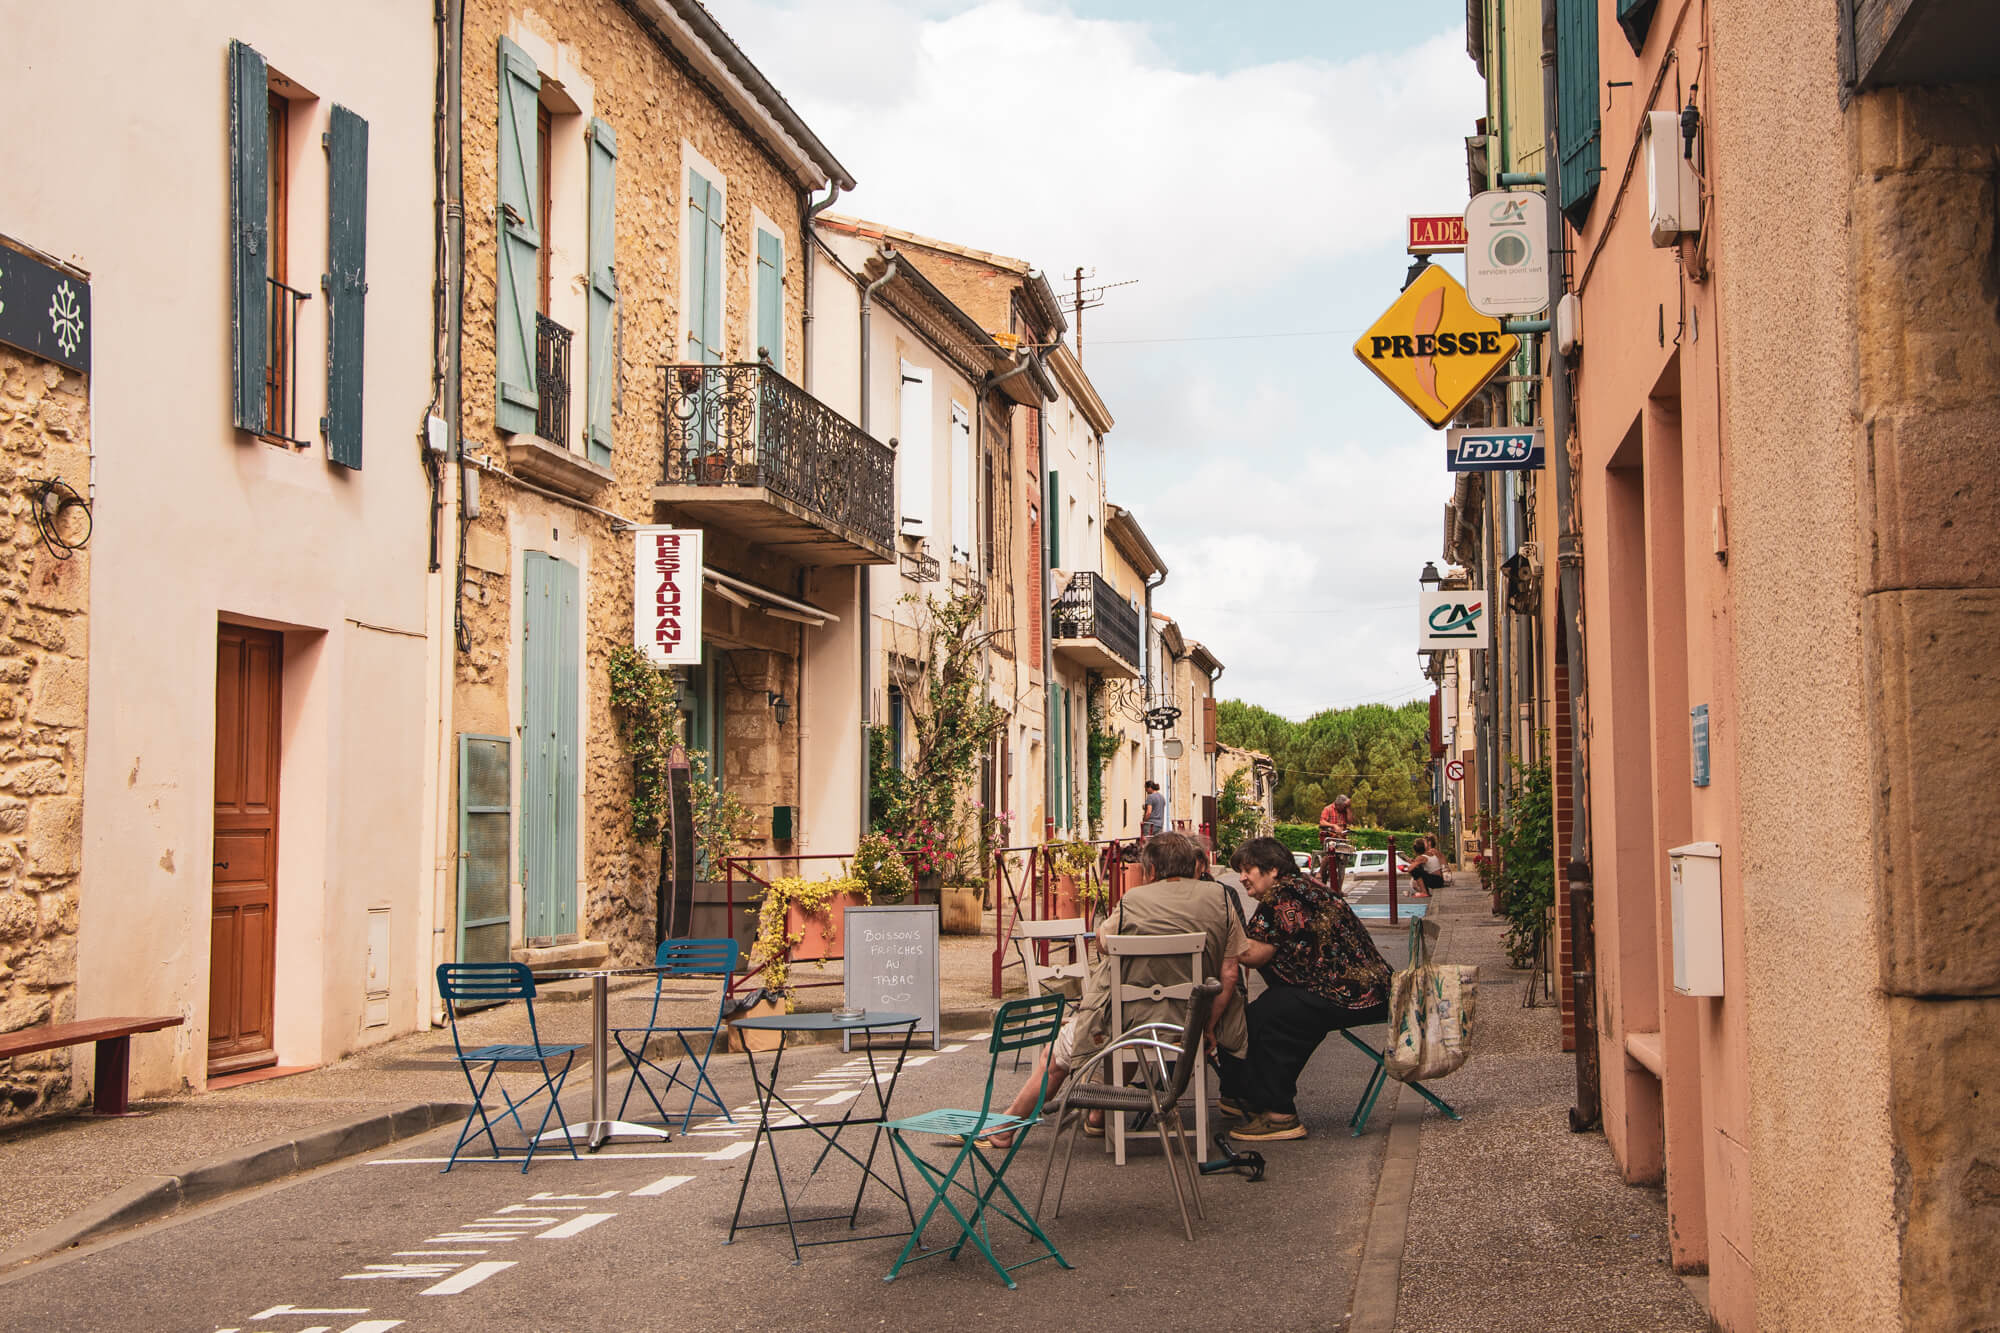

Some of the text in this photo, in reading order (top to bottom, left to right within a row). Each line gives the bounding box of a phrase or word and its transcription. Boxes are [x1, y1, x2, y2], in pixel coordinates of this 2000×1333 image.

[1412, 221, 1435, 242] LA
[1371, 331, 1501, 359] PRESSE
[1462, 440, 1505, 459] FDJ
[655, 534, 681, 654] RESTAURANT
[886, 959, 900, 969] AU
[873, 975, 914, 986] TABAC
[339, 1190, 624, 1281] MINUTE
